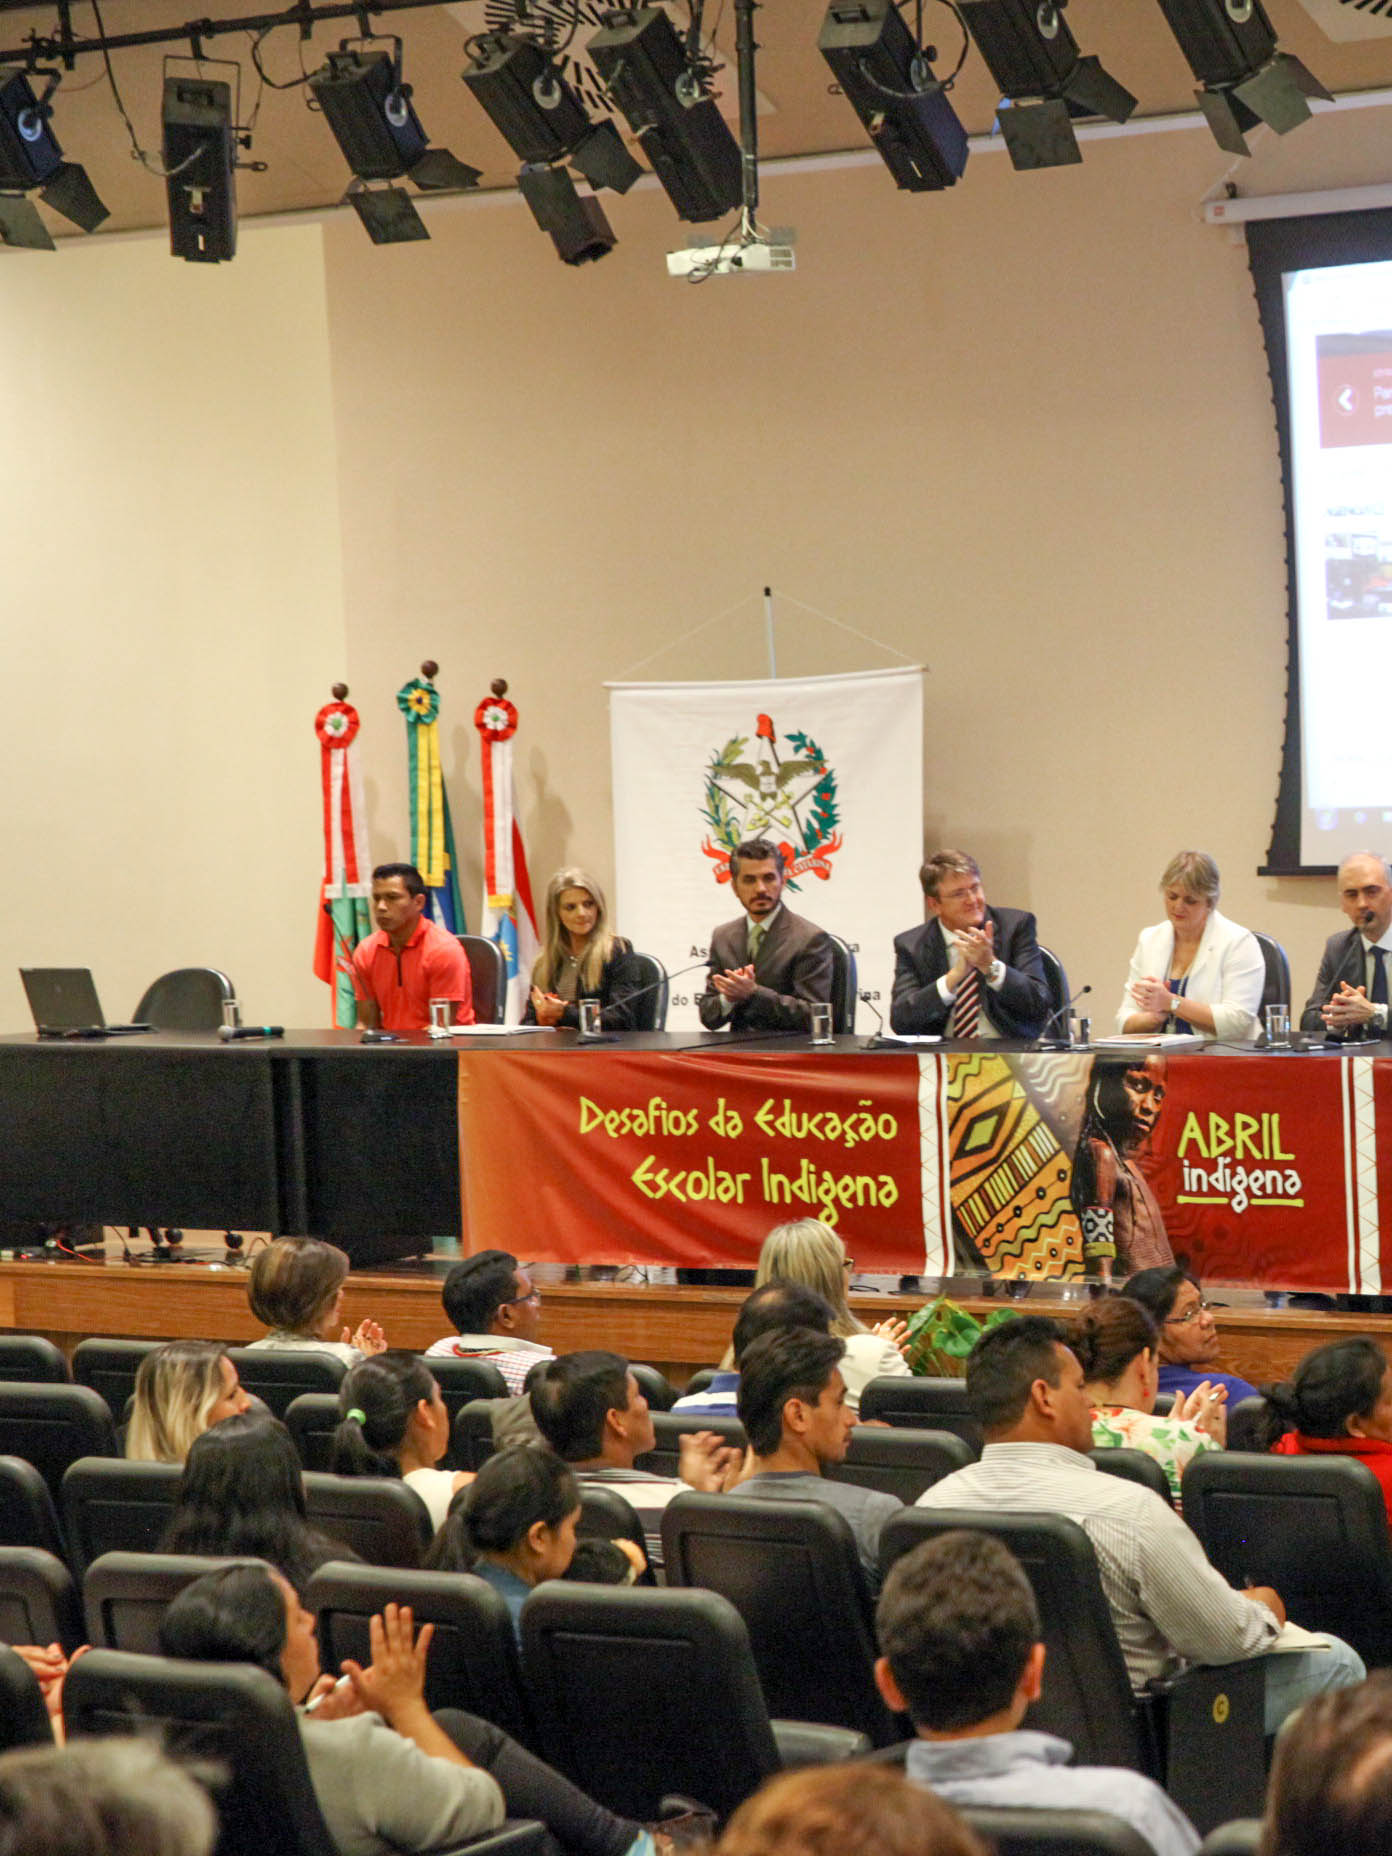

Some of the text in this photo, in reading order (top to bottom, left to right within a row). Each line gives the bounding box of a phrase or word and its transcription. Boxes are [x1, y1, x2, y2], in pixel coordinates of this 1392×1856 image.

[580, 1096, 898, 1148] Desafios da Educação
[1177, 1111, 1296, 1160] ABRIL
[631, 1155, 750, 1203] Escolar
